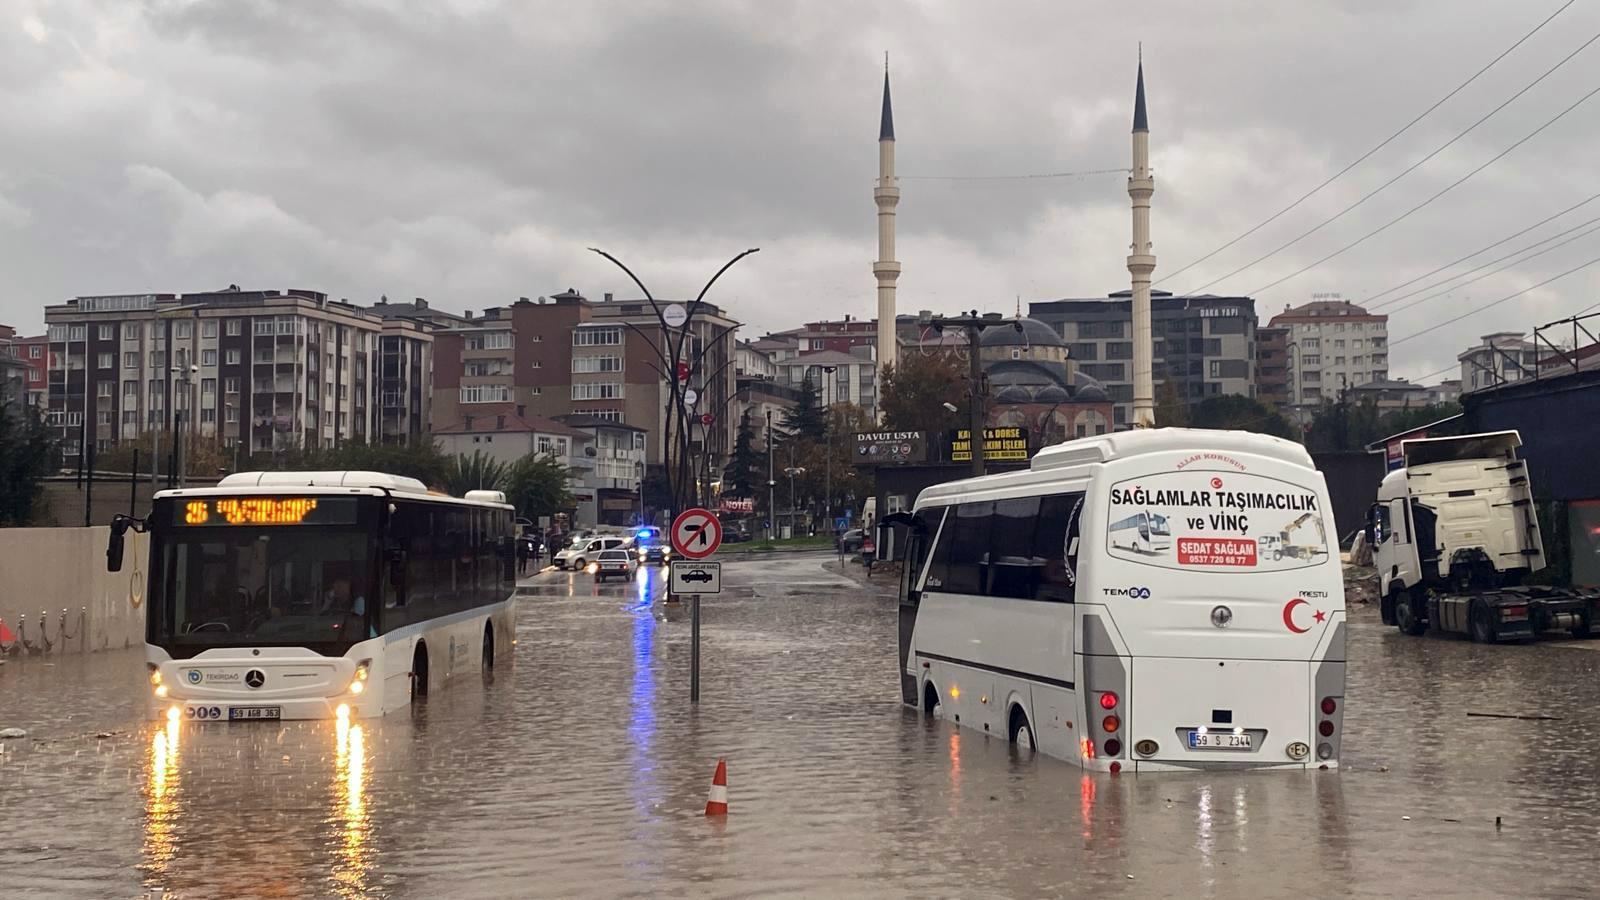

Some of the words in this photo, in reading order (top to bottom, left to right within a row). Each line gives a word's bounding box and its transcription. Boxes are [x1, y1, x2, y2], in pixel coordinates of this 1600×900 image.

[857, 432, 891, 441] DAVUT
[894, 431, 920, 440] USTA
[1111, 486, 1211, 507] SAĞLAMLAR
[1216, 491, 1316, 512] TAŞIMACILIK
[1187, 517, 1205, 530] ve
[1209, 510, 1248, 535] VİNÇ
[1181, 542, 1211, 554] SEDAT
[1214, 541, 1254, 555] SAĞLAM
[1103, 587, 1150, 599] TEMSA
[1196, 735, 1207, 745] 59
[1216, 736, 1221, 745] S
[1229, 736, 1250, 746] 2344
